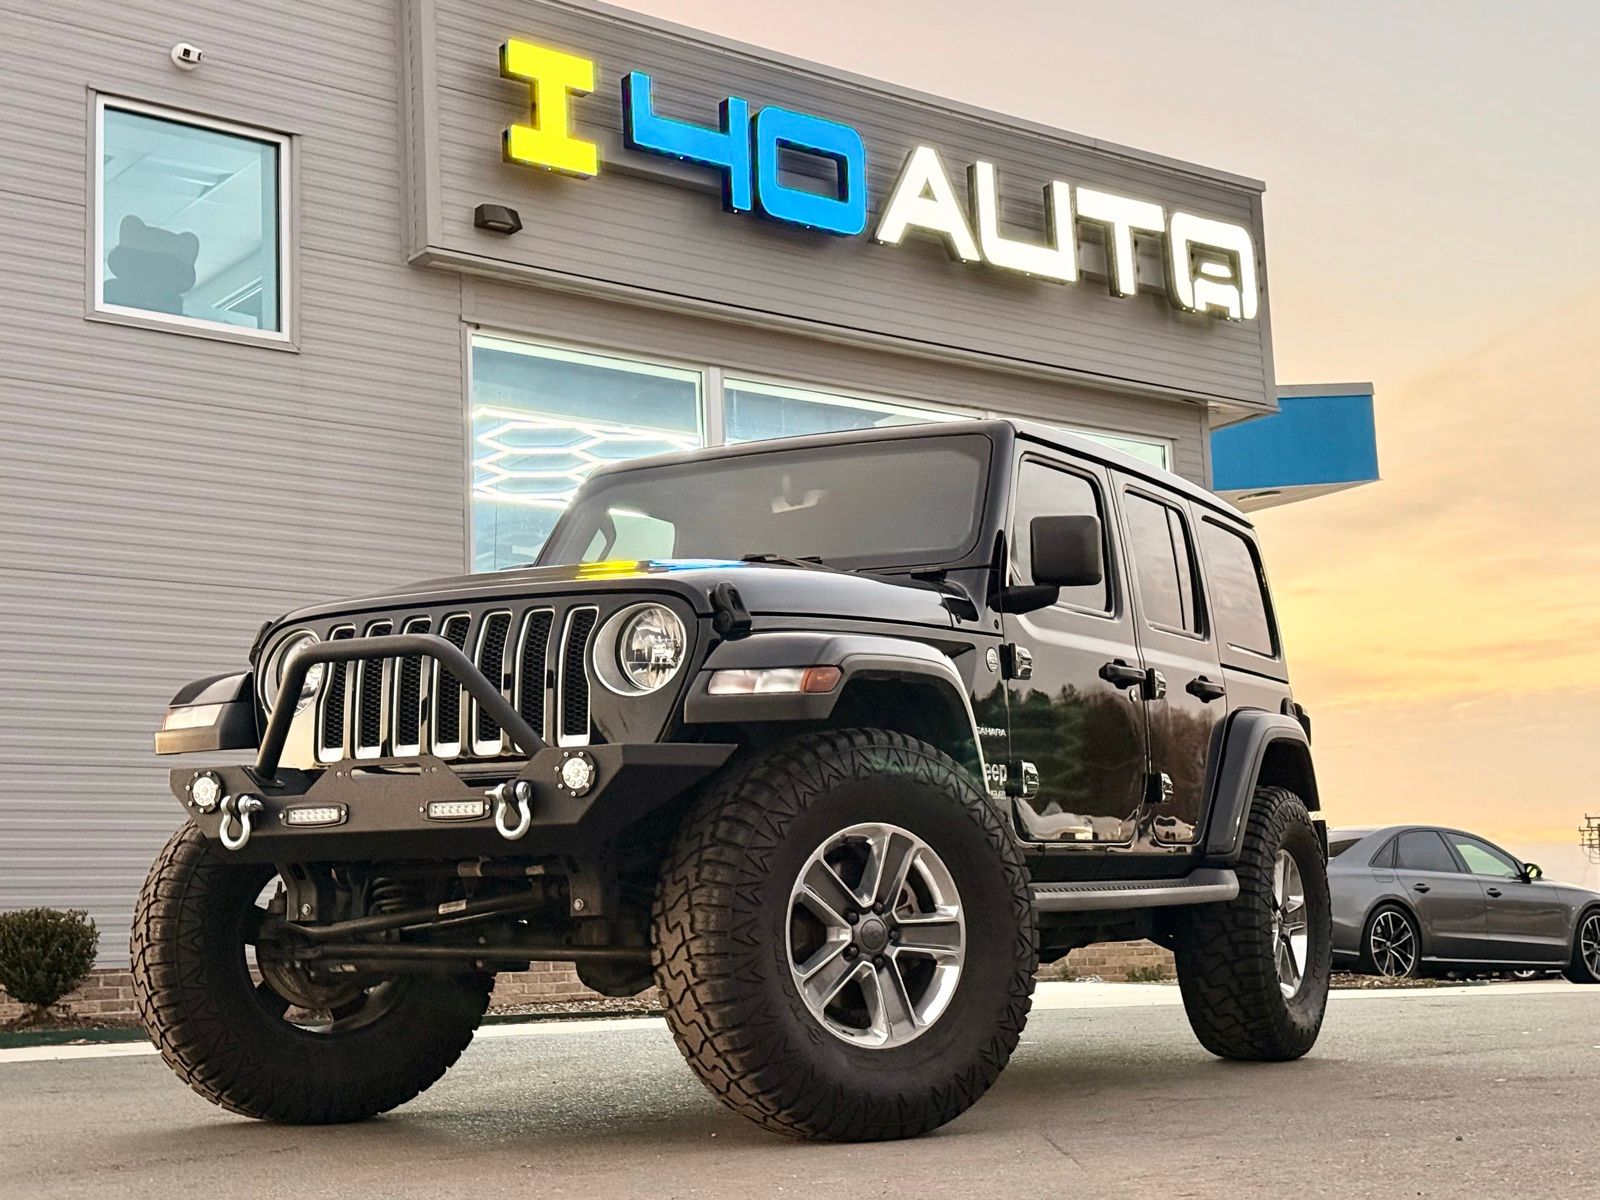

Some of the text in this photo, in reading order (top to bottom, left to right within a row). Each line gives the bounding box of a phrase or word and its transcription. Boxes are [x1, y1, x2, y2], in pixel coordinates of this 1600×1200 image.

[501, 38, 598, 177] I
[622, 70, 867, 236] 40
[985, 763, 1007, 785] eep
